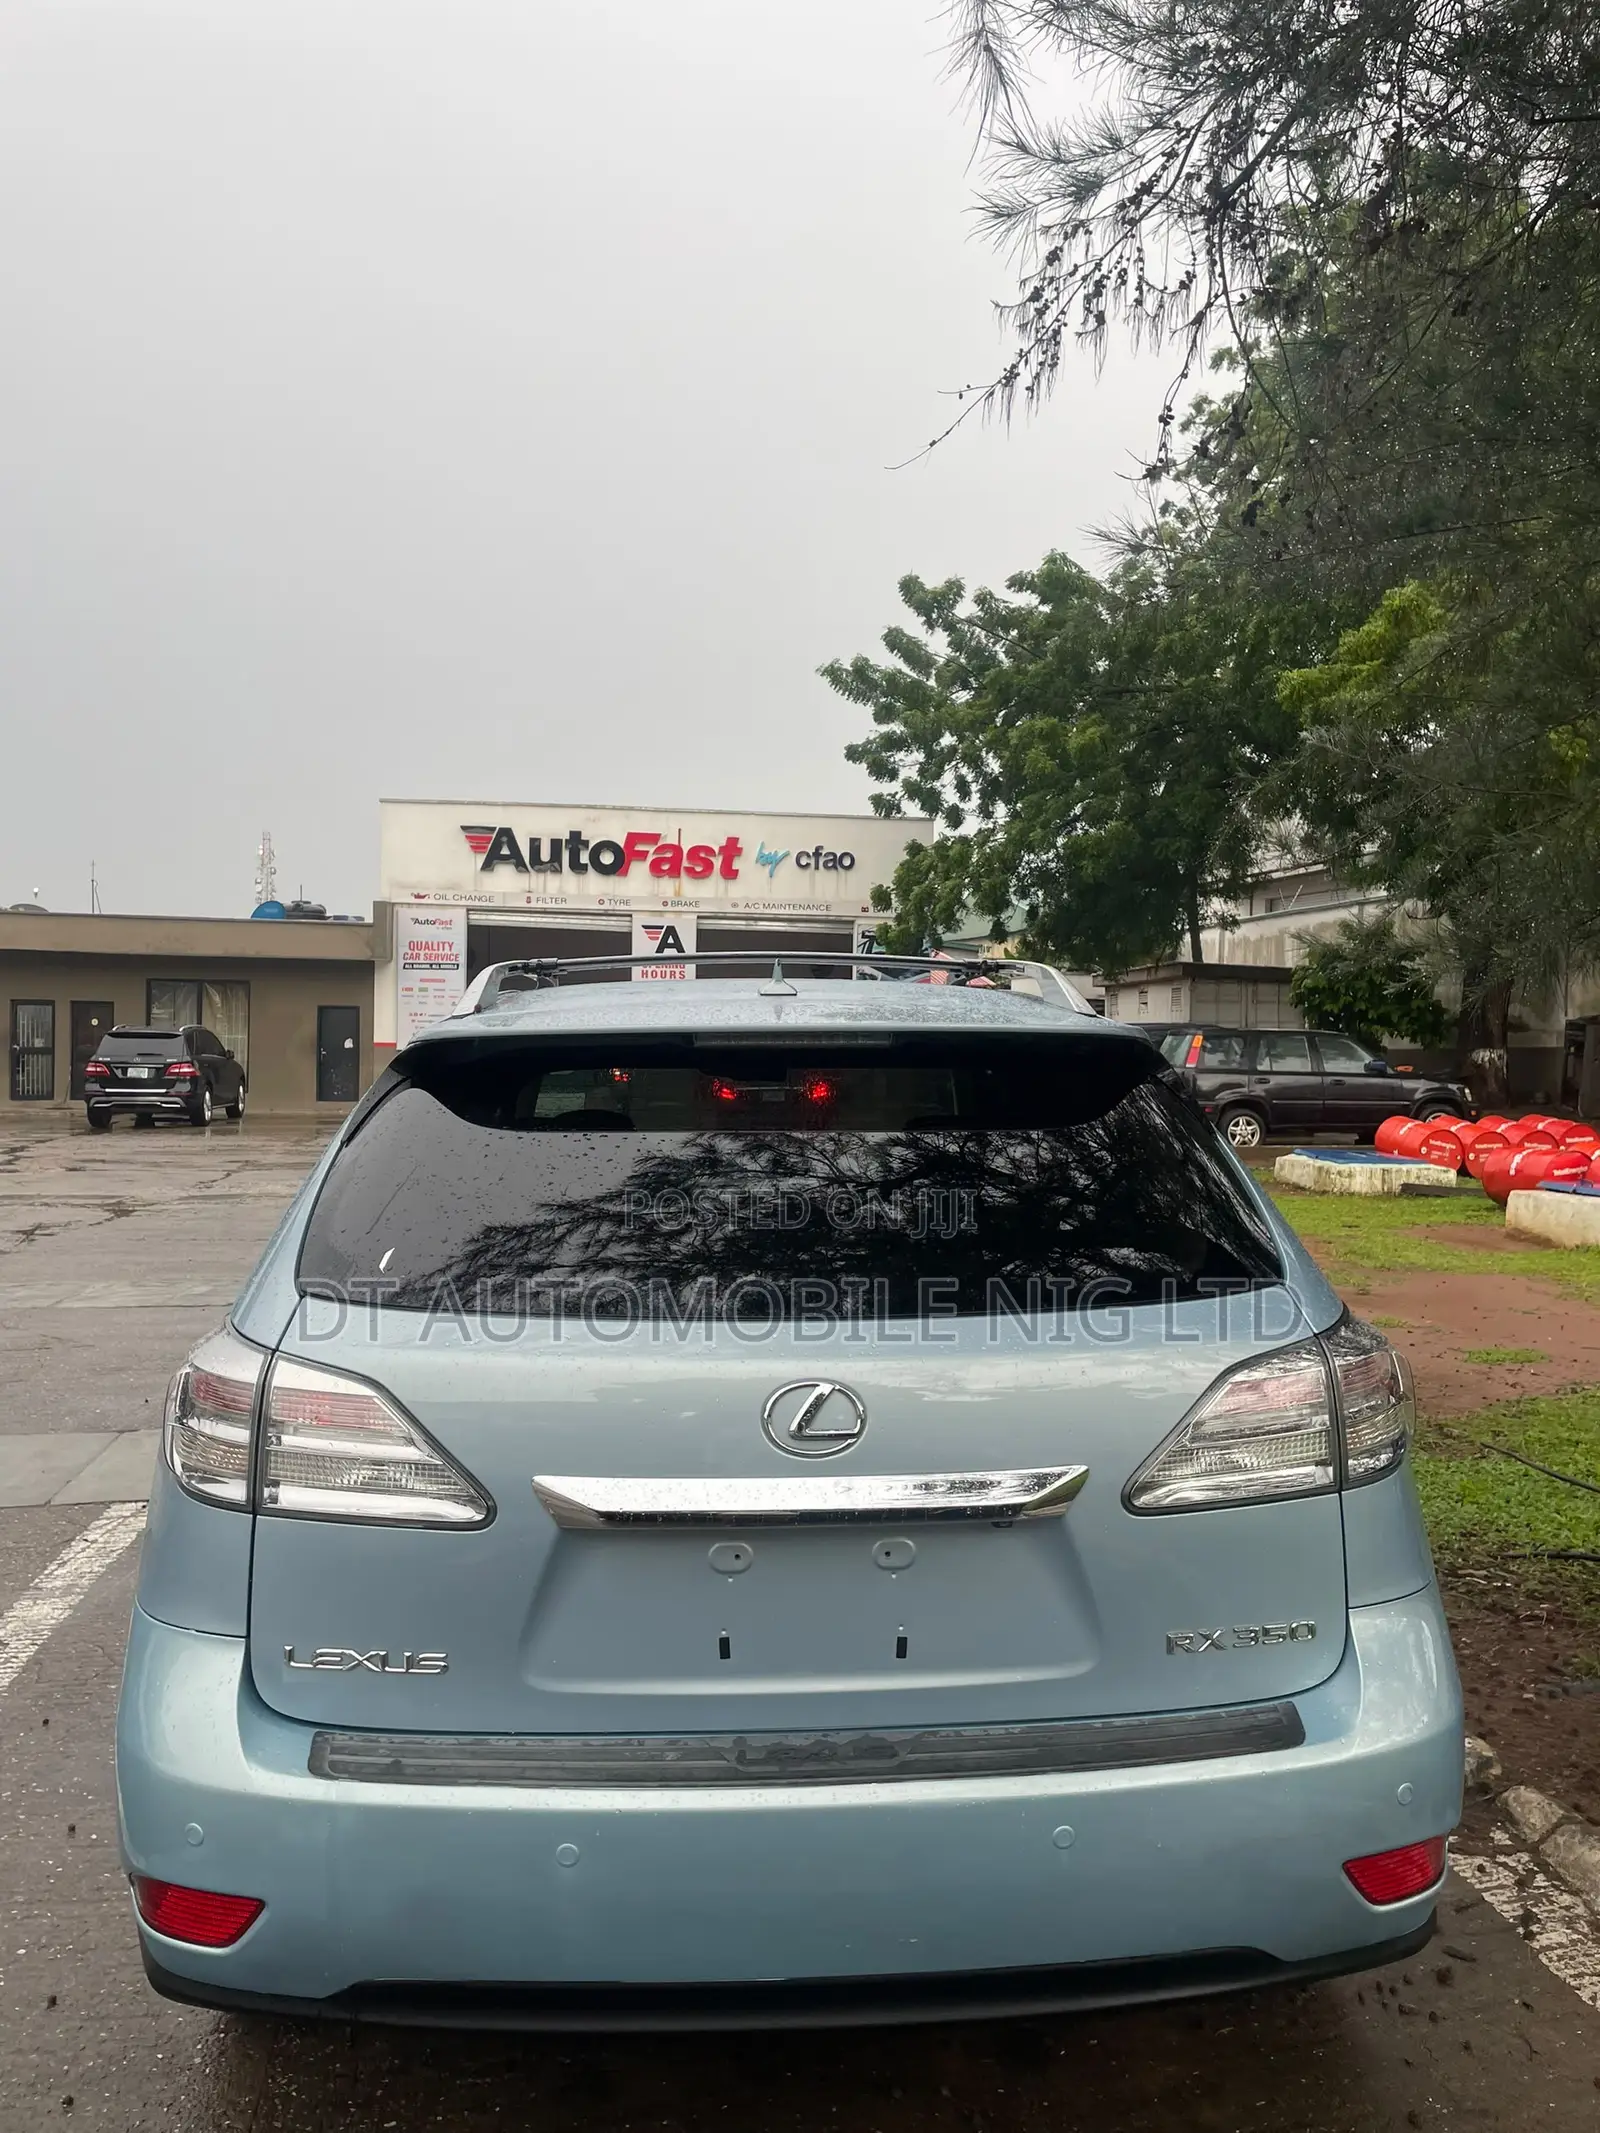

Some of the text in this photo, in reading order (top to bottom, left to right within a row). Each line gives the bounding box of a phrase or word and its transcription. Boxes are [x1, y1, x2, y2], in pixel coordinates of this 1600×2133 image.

[480, 826, 856, 880] AutoFast by cfao
[433, 893, 495, 903] OIL CHANGE
[536, 896, 567, 905] FILTER
[608, 898, 631, 906] TYRE
[670, 900, 700, 908] BRAKE
[762, 903, 832, 912] MAINTENANCE
[413, 918, 453, 926] AutoFast
[655, 925, 686, 953] A
[408, 940, 454, 951] QUALITY
[403, 951, 460, 962] CAR SERVICE
[641, 969, 686, 980] HOURS
[1165, 1619, 1317, 1655] RX 350
[283, 1645, 449, 1674] LEXUS
